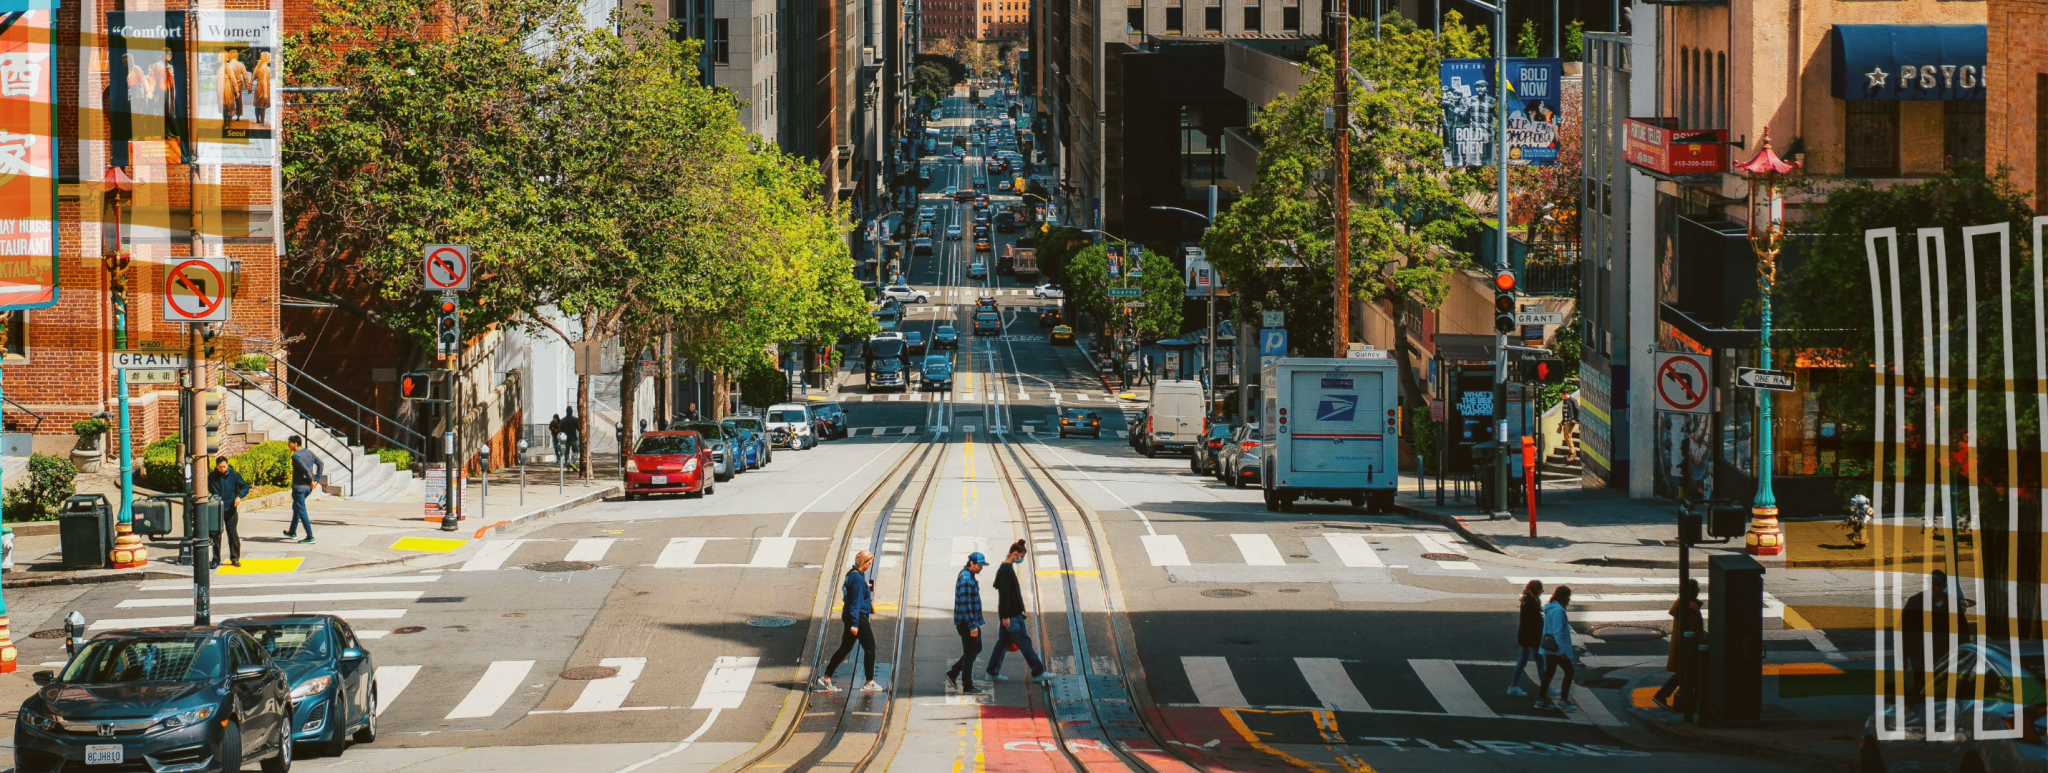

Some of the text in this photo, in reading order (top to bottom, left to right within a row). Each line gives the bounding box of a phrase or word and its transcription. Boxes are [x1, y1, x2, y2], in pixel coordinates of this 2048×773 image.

[1520, 68, 1548, 80] BOLD
[1520, 82, 1548, 96] NOW
[1456, 128, 1483, 140] BOLD
[1536, 123, 1550, 133] END
[1631, 122, 1646, 141] FORTUNE
[1648, 128, 1661, 146] TELLER
[1456, 140, 1484, 154] THEN
[19, 216, 51, 232] HOUSE
[119, 353, 182, 365] GRANT
[1772, 376, 1787, 384] WAY
[1358, 736, 1651, 756] TURNS
[88, 752, 120, 761] 8CJH810
